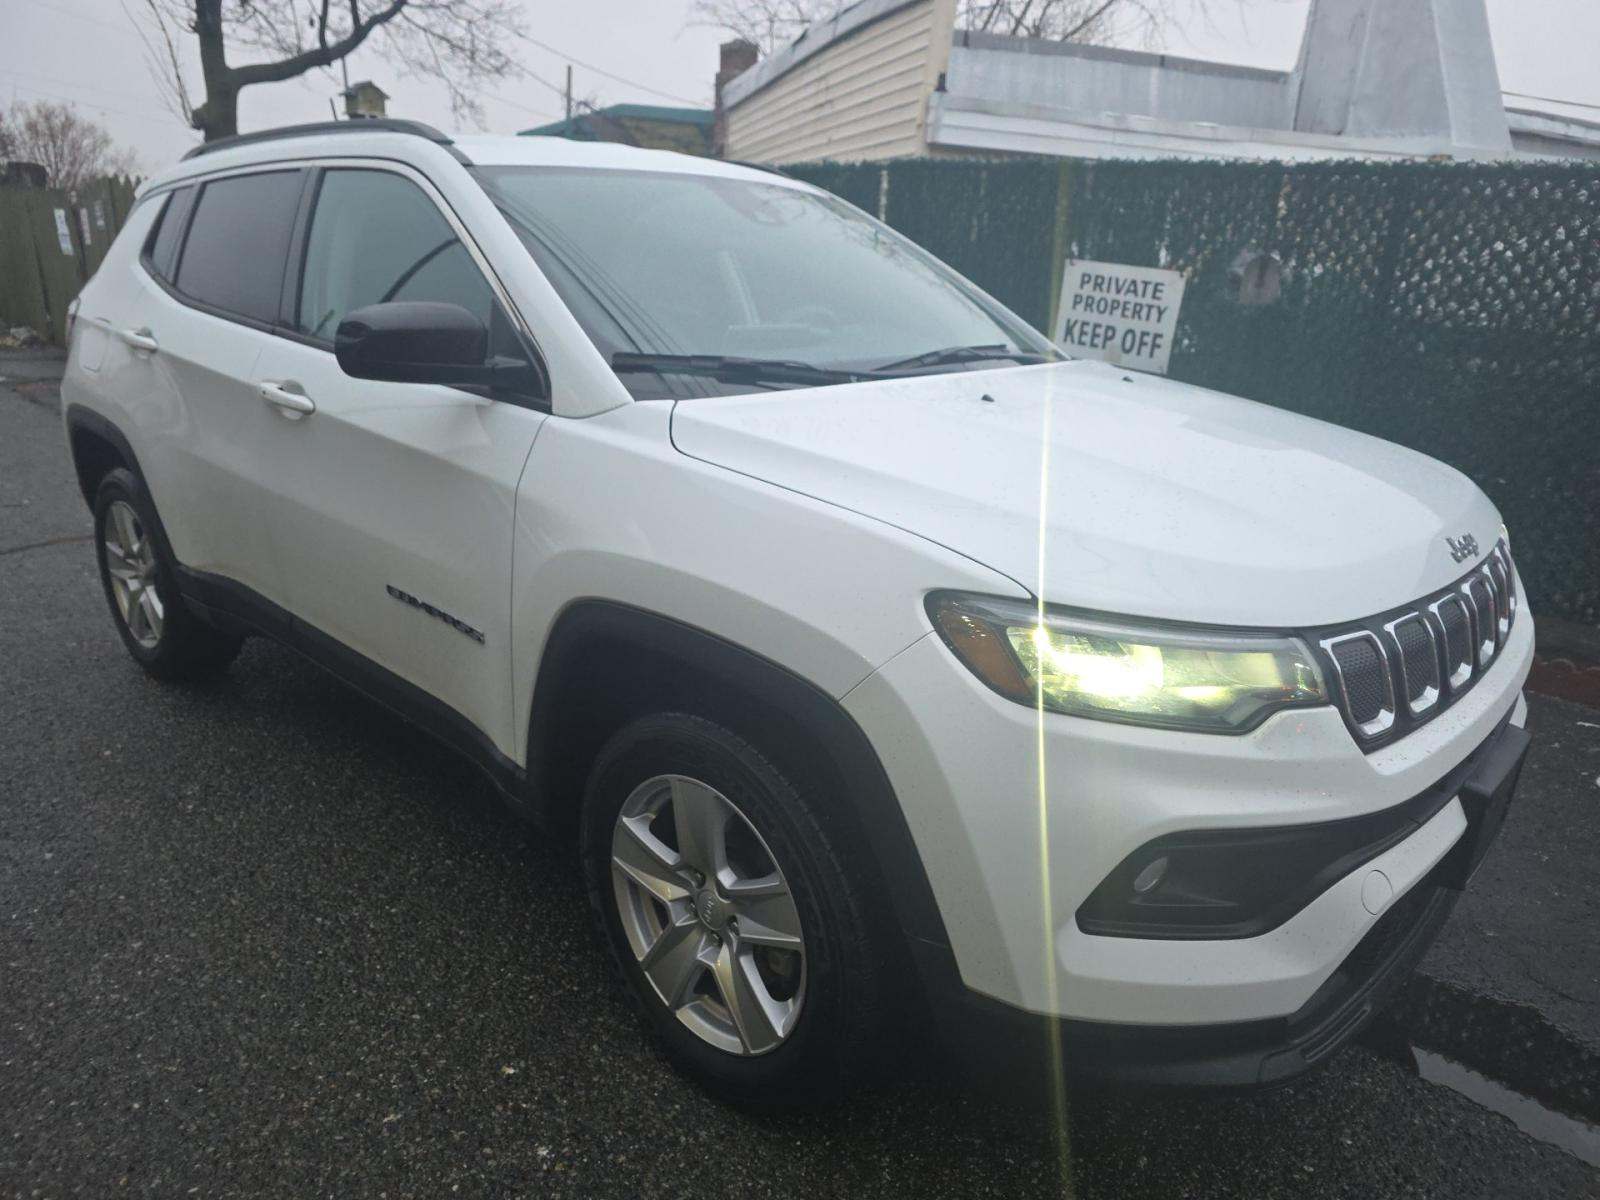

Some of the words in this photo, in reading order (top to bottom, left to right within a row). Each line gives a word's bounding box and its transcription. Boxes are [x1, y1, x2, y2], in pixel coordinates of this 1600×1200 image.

[1080, 273, 1165, 300] PRIVATE
[1072, 294, 1168, 323] PROPERTY
[1063, 318, 1116, 349] KEEP
[1121, 328, 1163, 358] OFF
